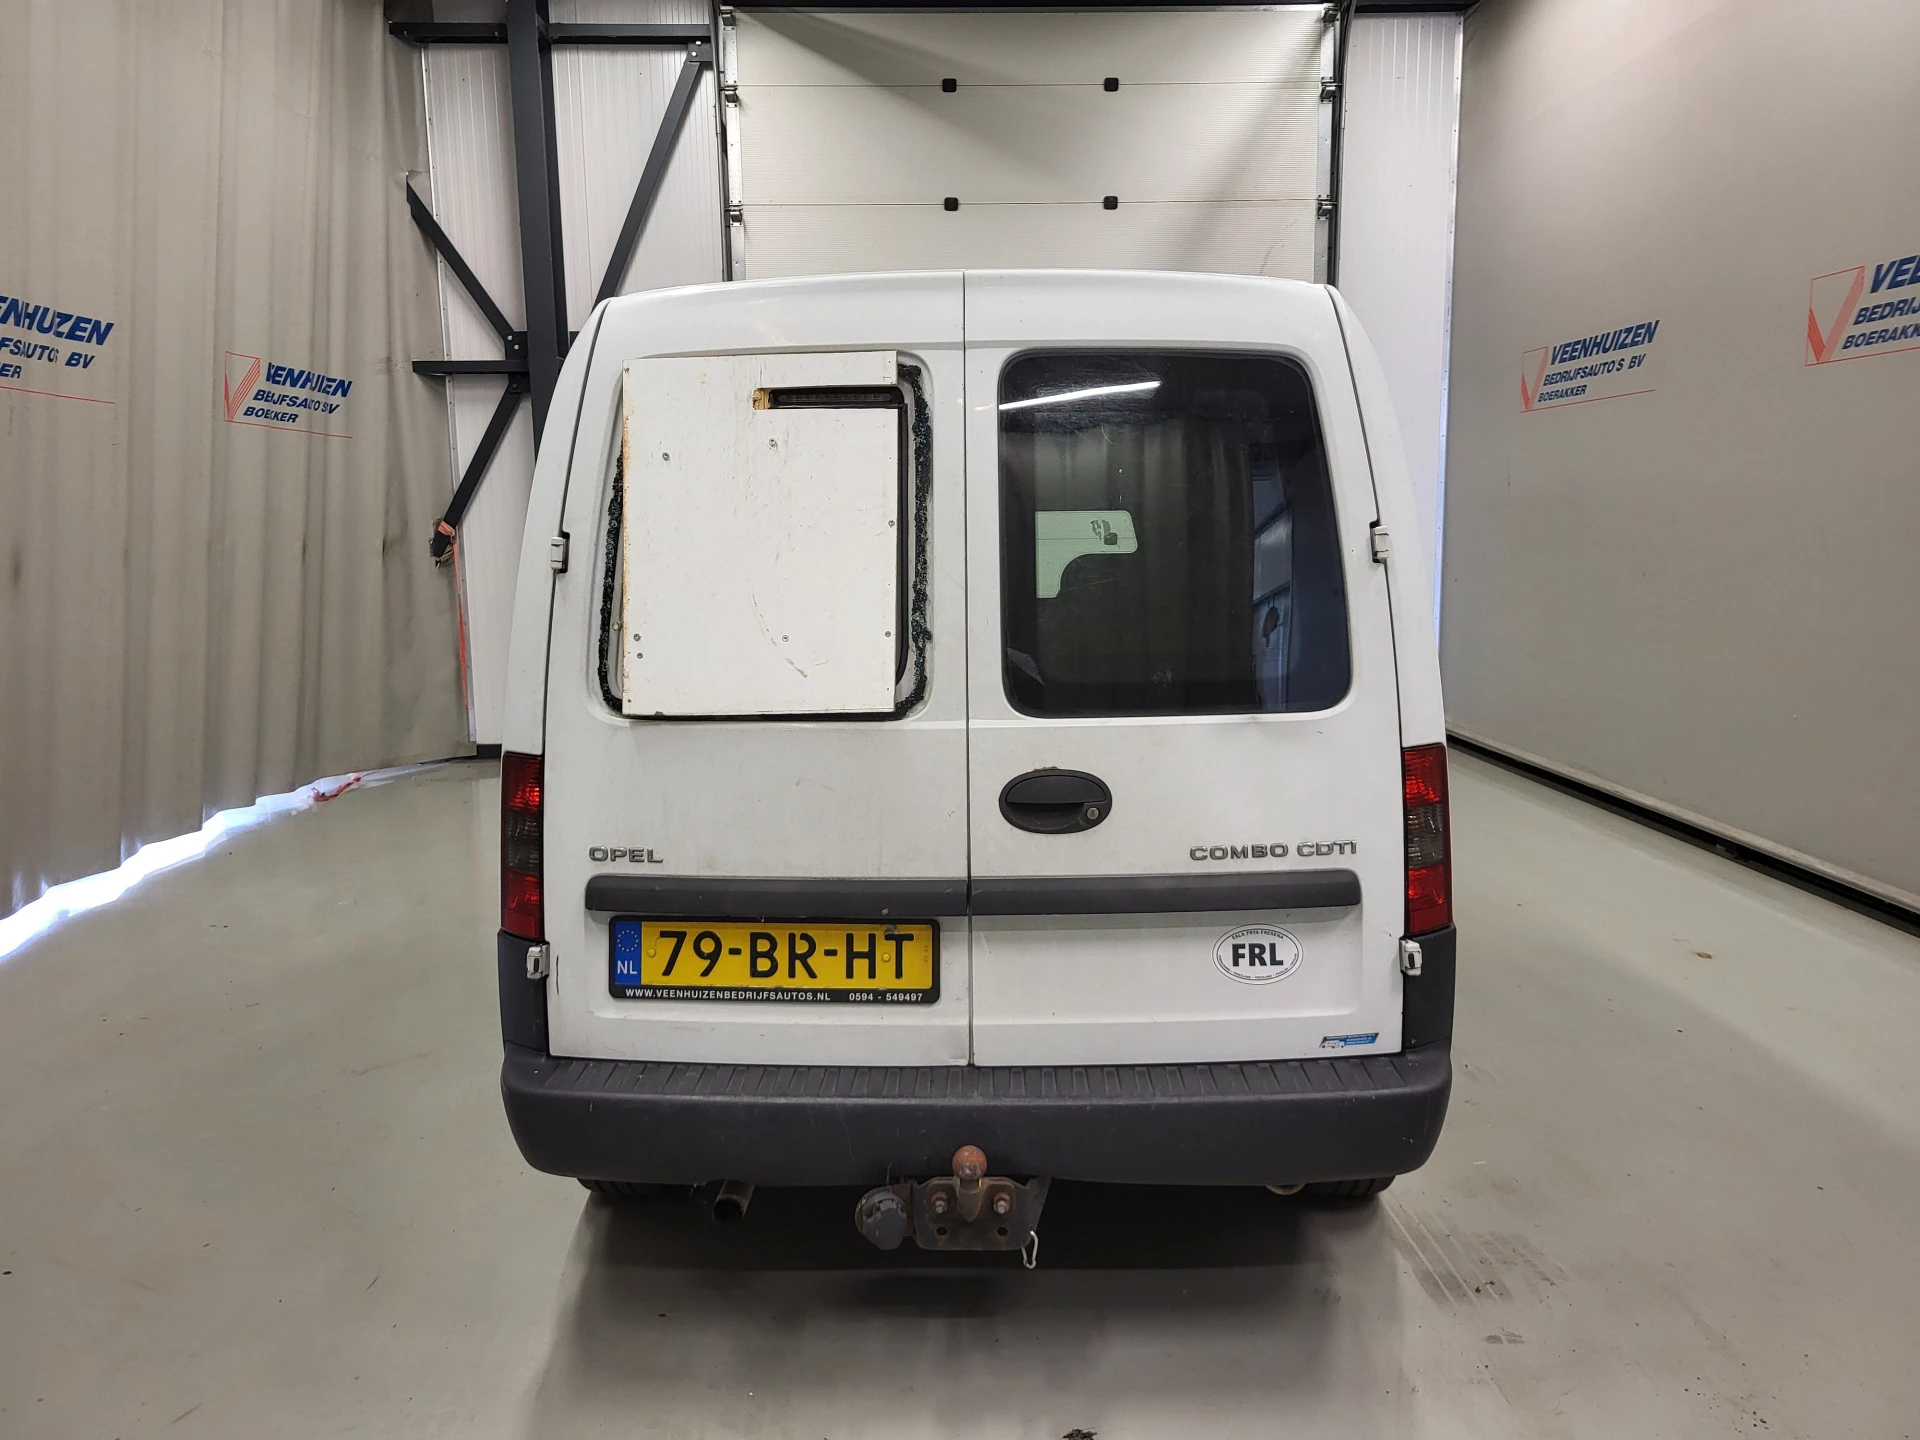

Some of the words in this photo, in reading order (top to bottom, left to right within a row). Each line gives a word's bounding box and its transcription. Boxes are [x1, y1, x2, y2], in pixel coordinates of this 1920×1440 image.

[1550, 320, 1660, 366] VEENHUIZEN
[65, 352, 95, 369] BV
[1543, 358, 1625, 386] BEDRIJFSAUTO'S
[1628, 353, 1647, 370] BV
[1537, 384, 1588, 402] BOERAKKER
[589, 845, 664, 863] OPEL
[1190, 842, 1289, 861] COMBO
[1297, 839, 1357, 857] CDTI
[659, 930, 915, 980] 79-BR-HT
[1231, 942, 1284, 967] FRL
[616, 960, 638, 976] NL
[625, 988, 831, 1001] WWW.VEENHUIZENBEDRIJFSAUTOS.NL
[848, 992, 874, 1002] 0594
[885, 992, 923, 1002] 549497
